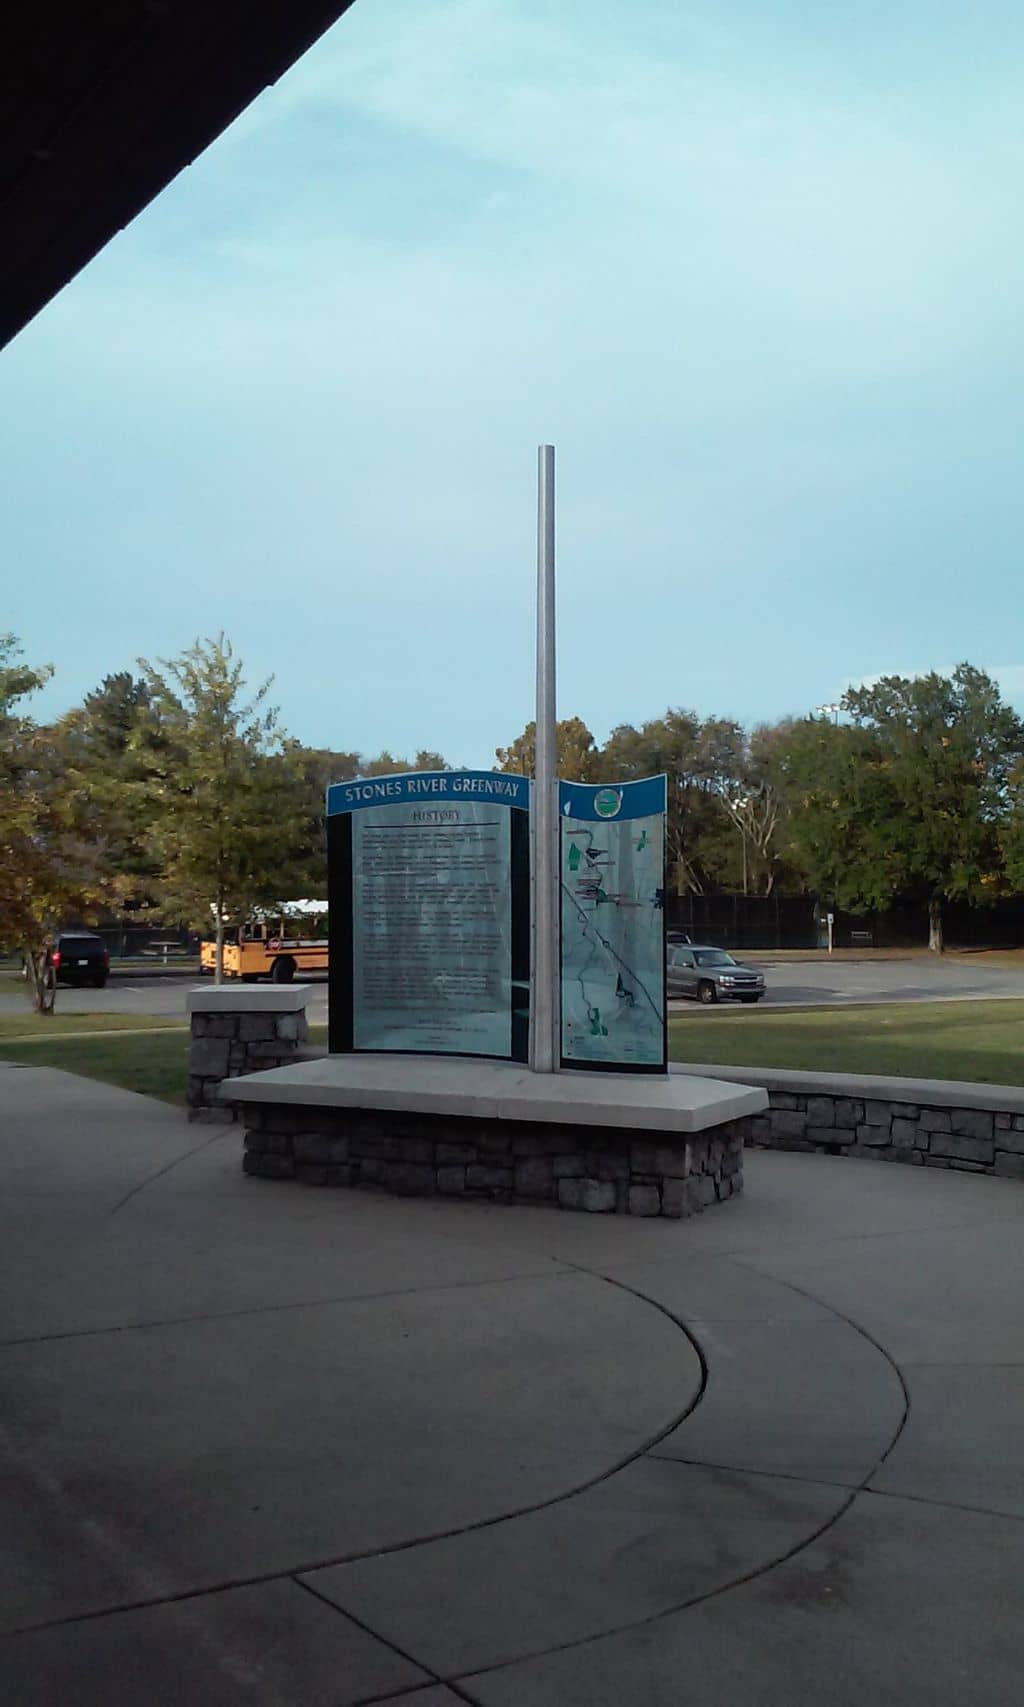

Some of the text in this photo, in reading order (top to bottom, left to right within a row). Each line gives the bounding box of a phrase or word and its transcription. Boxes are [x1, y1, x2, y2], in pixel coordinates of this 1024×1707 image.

[345, 778, 519, 801] STONES RIVER GREENWAY
[413, 810, 460, 821] HISTORY
